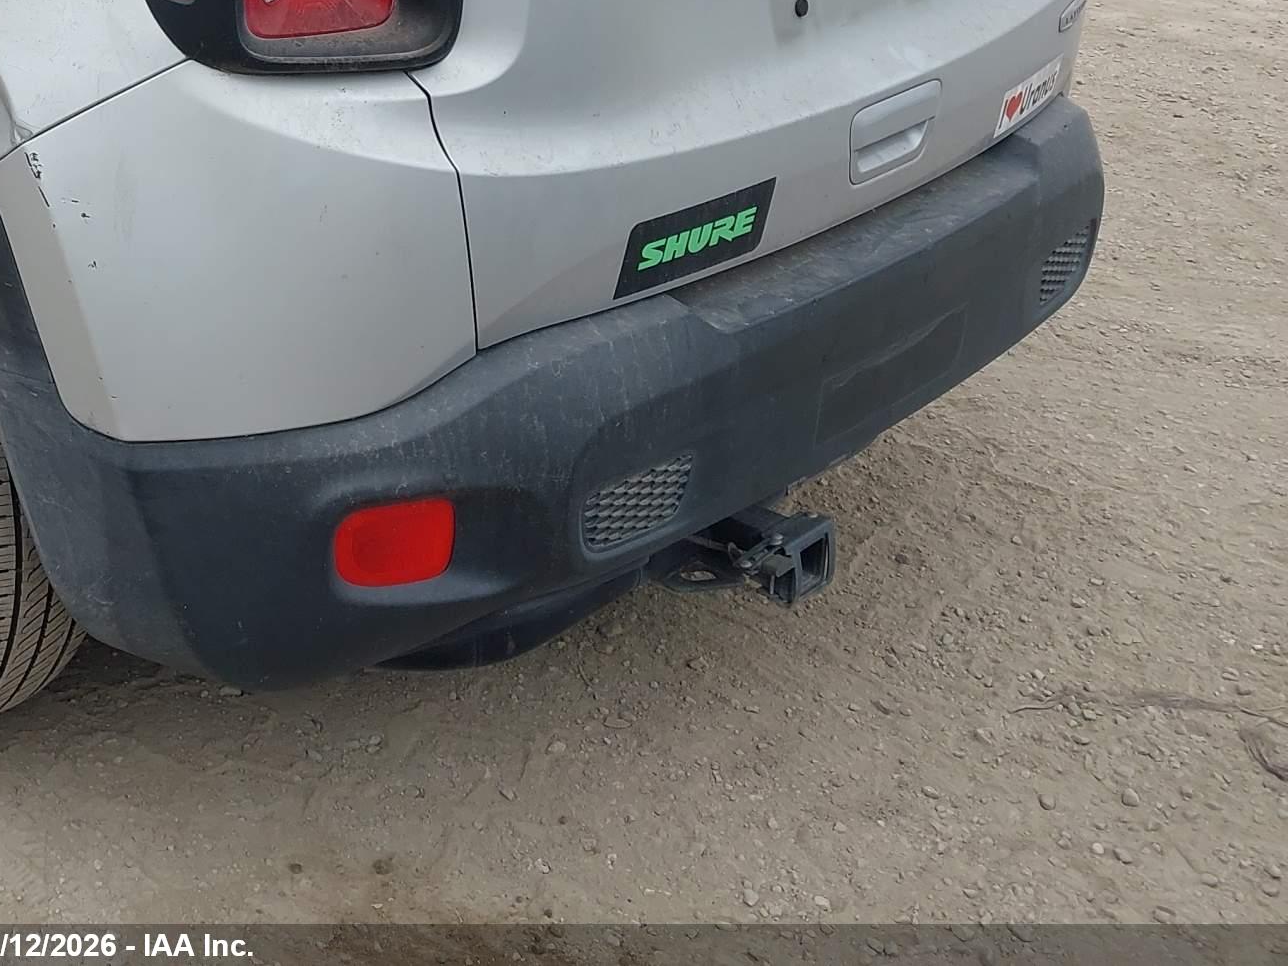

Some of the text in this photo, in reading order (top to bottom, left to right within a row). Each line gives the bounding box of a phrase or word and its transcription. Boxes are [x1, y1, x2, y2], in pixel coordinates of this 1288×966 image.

[998, 70, 1058, 129] I Uranus
[637, 206, 758, 271] SHURE
